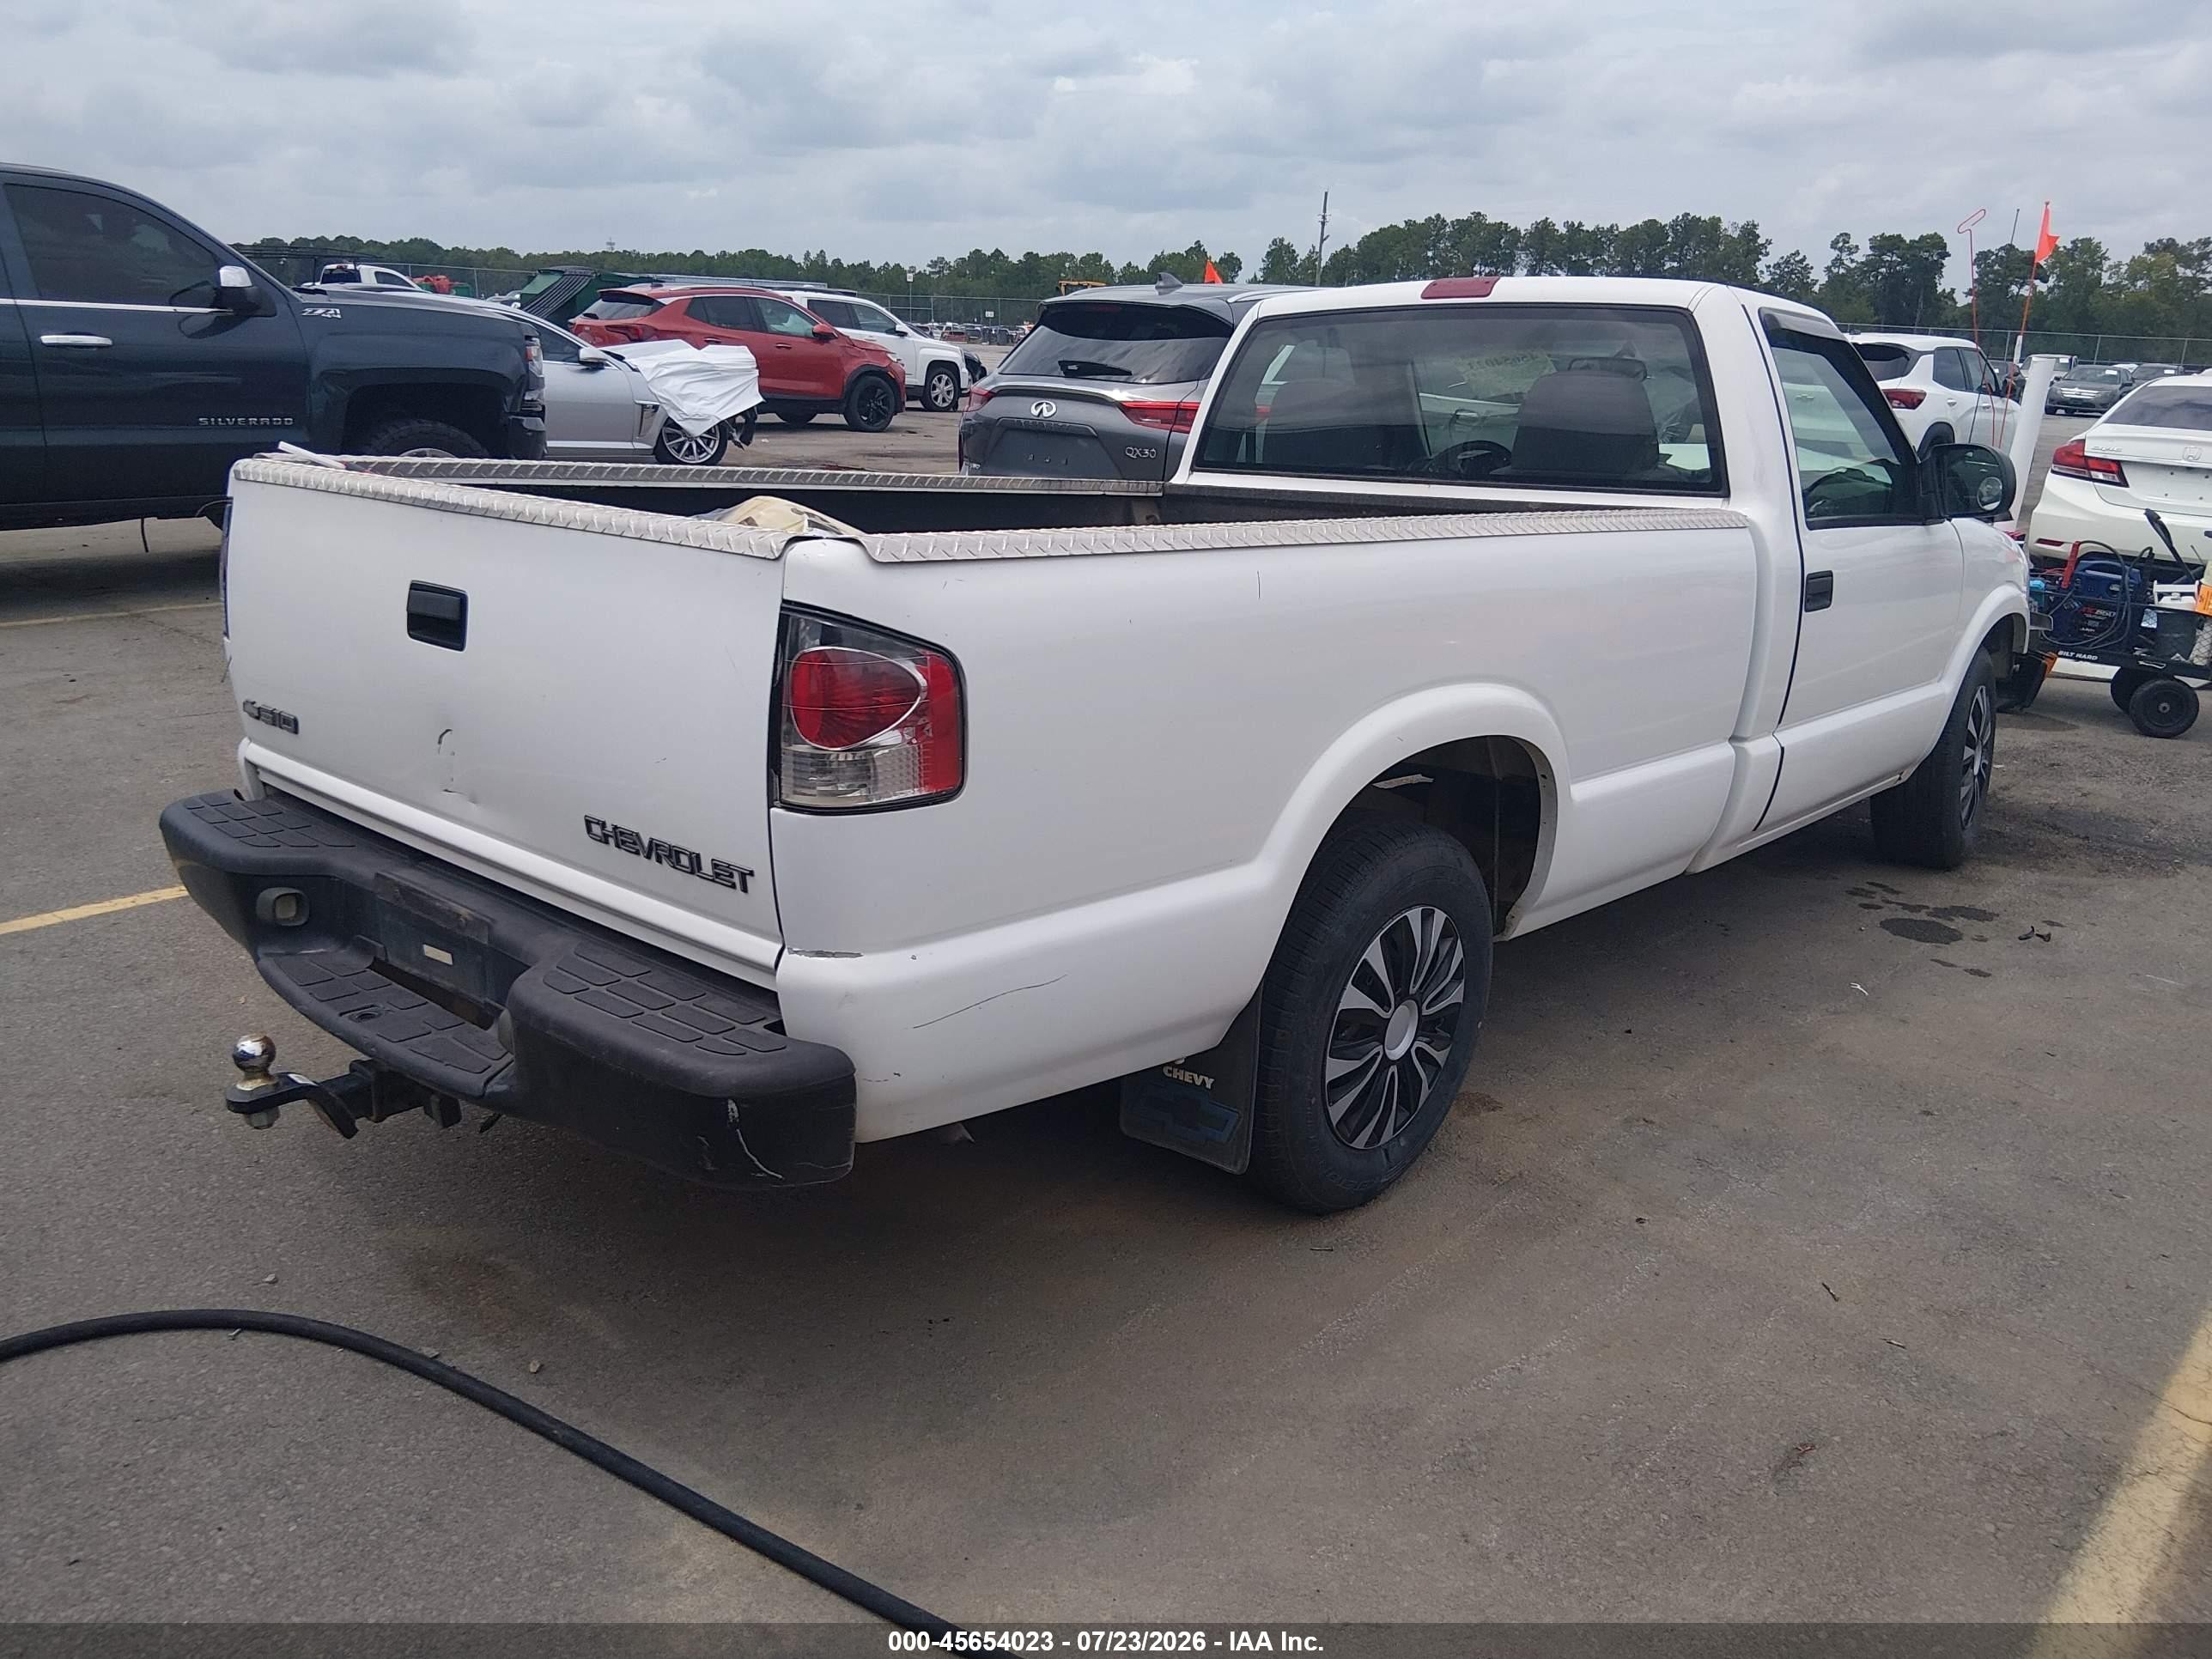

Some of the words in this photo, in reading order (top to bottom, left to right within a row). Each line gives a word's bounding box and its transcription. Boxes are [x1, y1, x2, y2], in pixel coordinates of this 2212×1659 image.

[198, 417, 295, 426] SILVERADO
[1125, 447, 1157, 459] QX30
[584, 814, 756, 894] CHEVROLET
[1162, 1066, 1215, 1090] CHEVY
